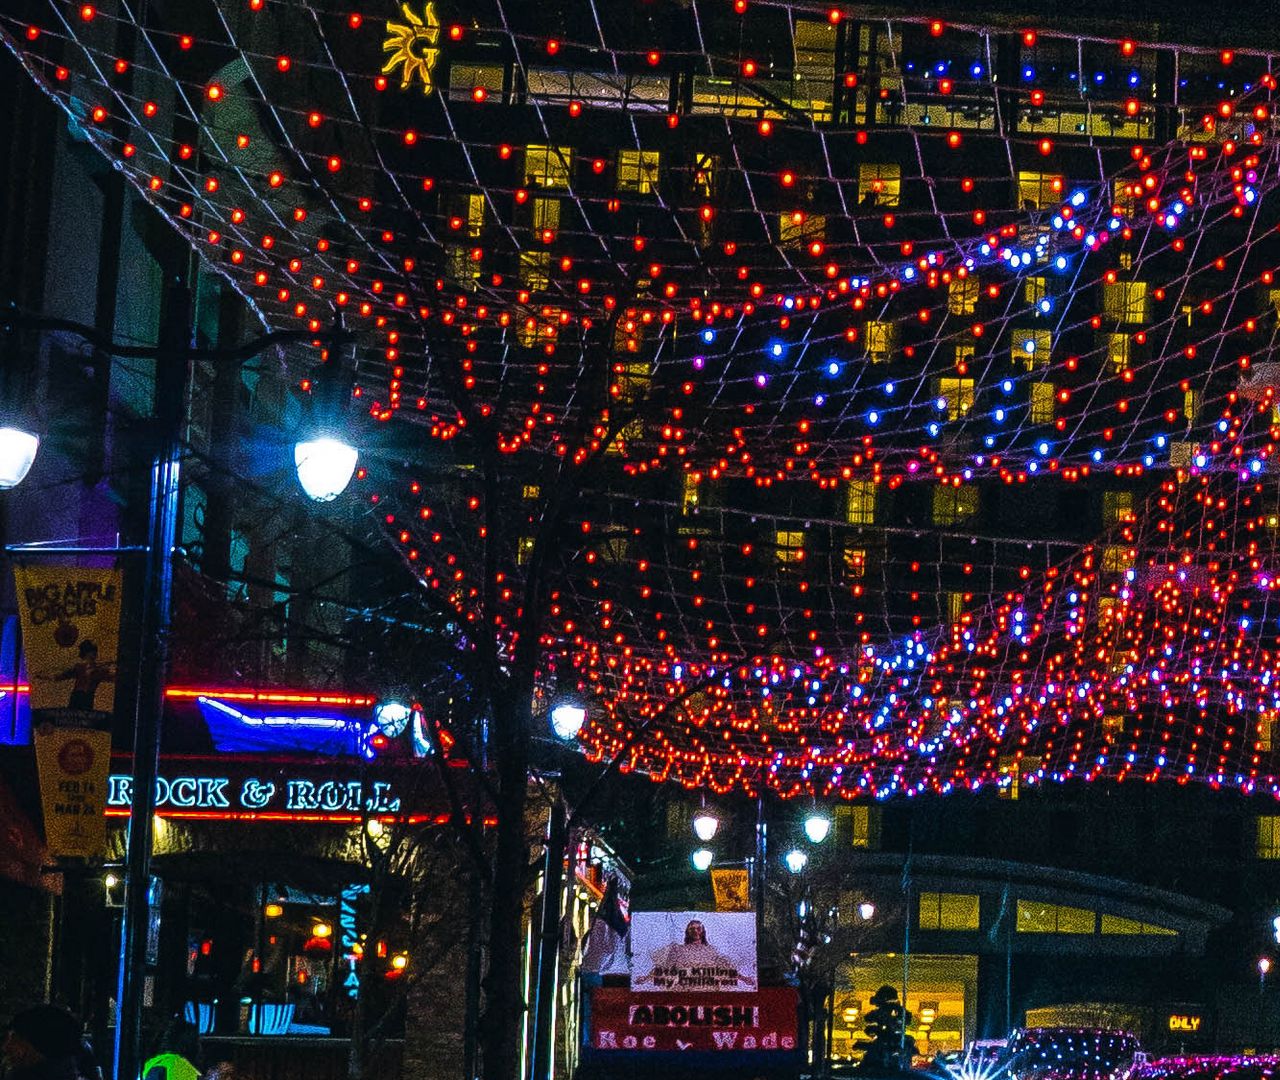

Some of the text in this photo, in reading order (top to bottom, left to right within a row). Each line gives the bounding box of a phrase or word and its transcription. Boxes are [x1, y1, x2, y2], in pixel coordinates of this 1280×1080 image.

[25, 580, 116, 608] BIG APPLE
[31, 599, 96, 625] CIRCUS
[107, 773, 401, 812] ROCK & ROLL
[653, 965, 738, 978] Stop Killing
[654, 976, 738, 988] My Children
[599, 1030, 657, 1049] Roe
[712, 1030, 795, 1049] Wade
